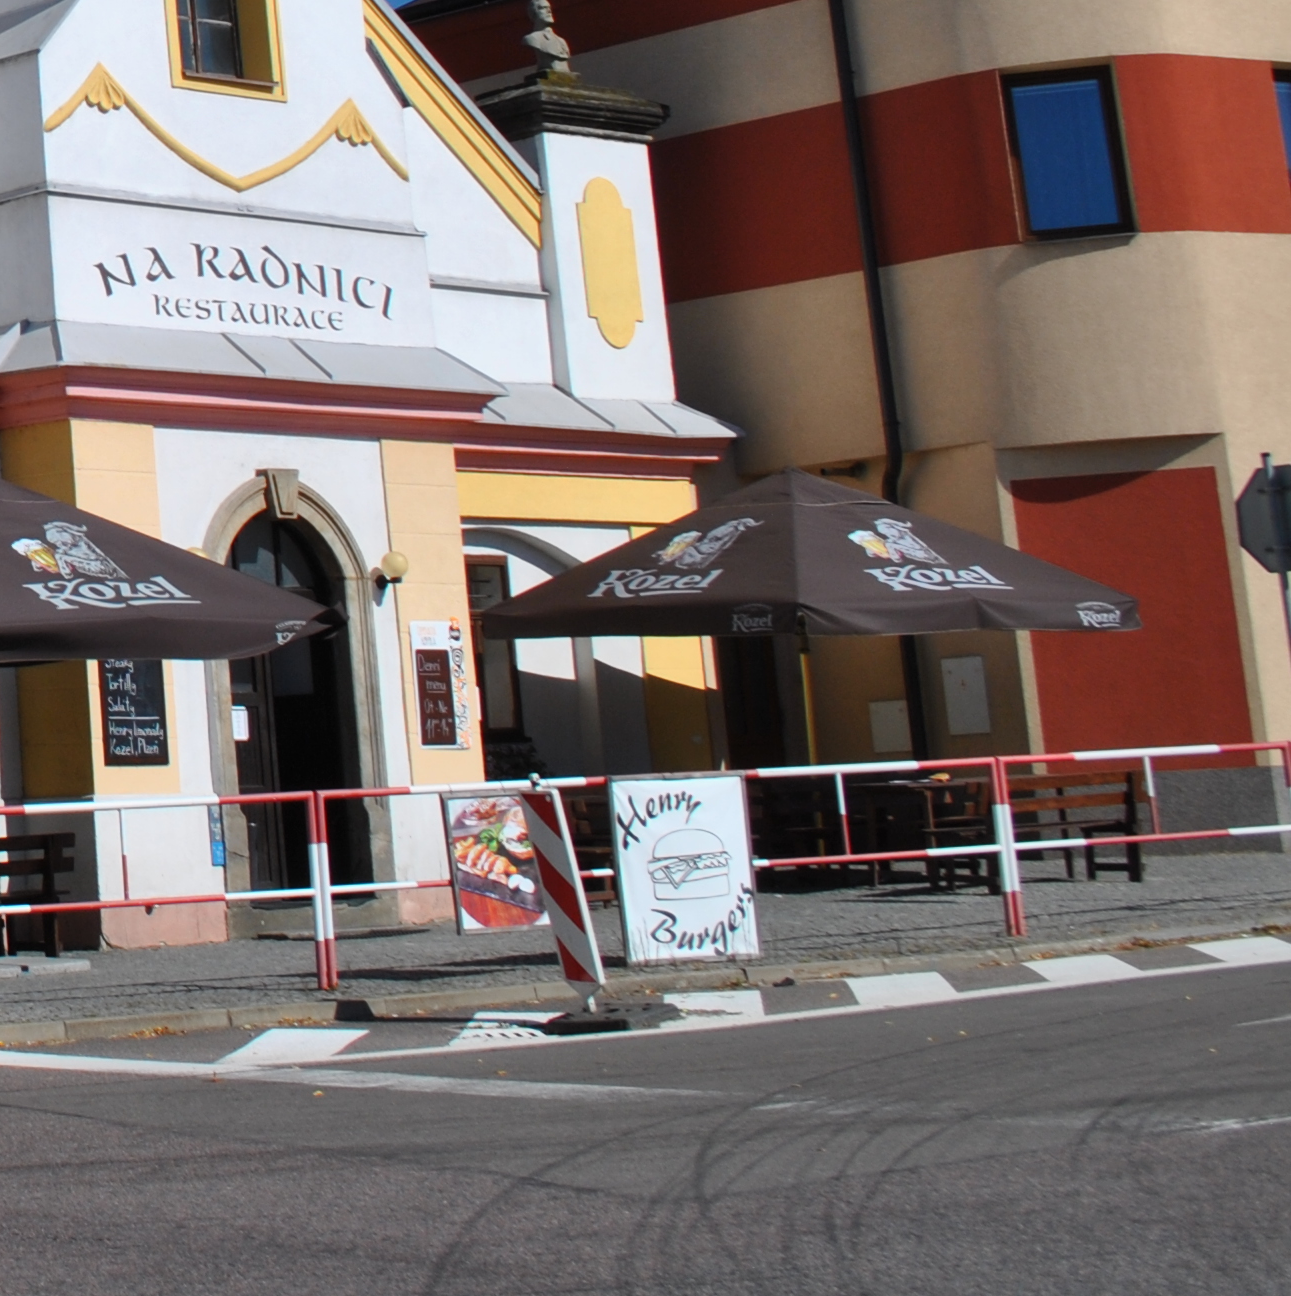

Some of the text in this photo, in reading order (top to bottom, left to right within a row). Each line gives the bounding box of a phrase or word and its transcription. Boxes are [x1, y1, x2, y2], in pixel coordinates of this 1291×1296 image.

[93, 242, 394, 321] NA RADNICI
[152, 293, 344, 331] RESTAURACE
[23, 576, 192, 610] Kozel
[587, 569, 724, 598] Kozel
[864, 565, 1007, 591] Kozel
[732, 614, 774, 633] Kozel
[1076, 610, 1122, 628] Kozel
[616, 791, 702, 850] Henry
